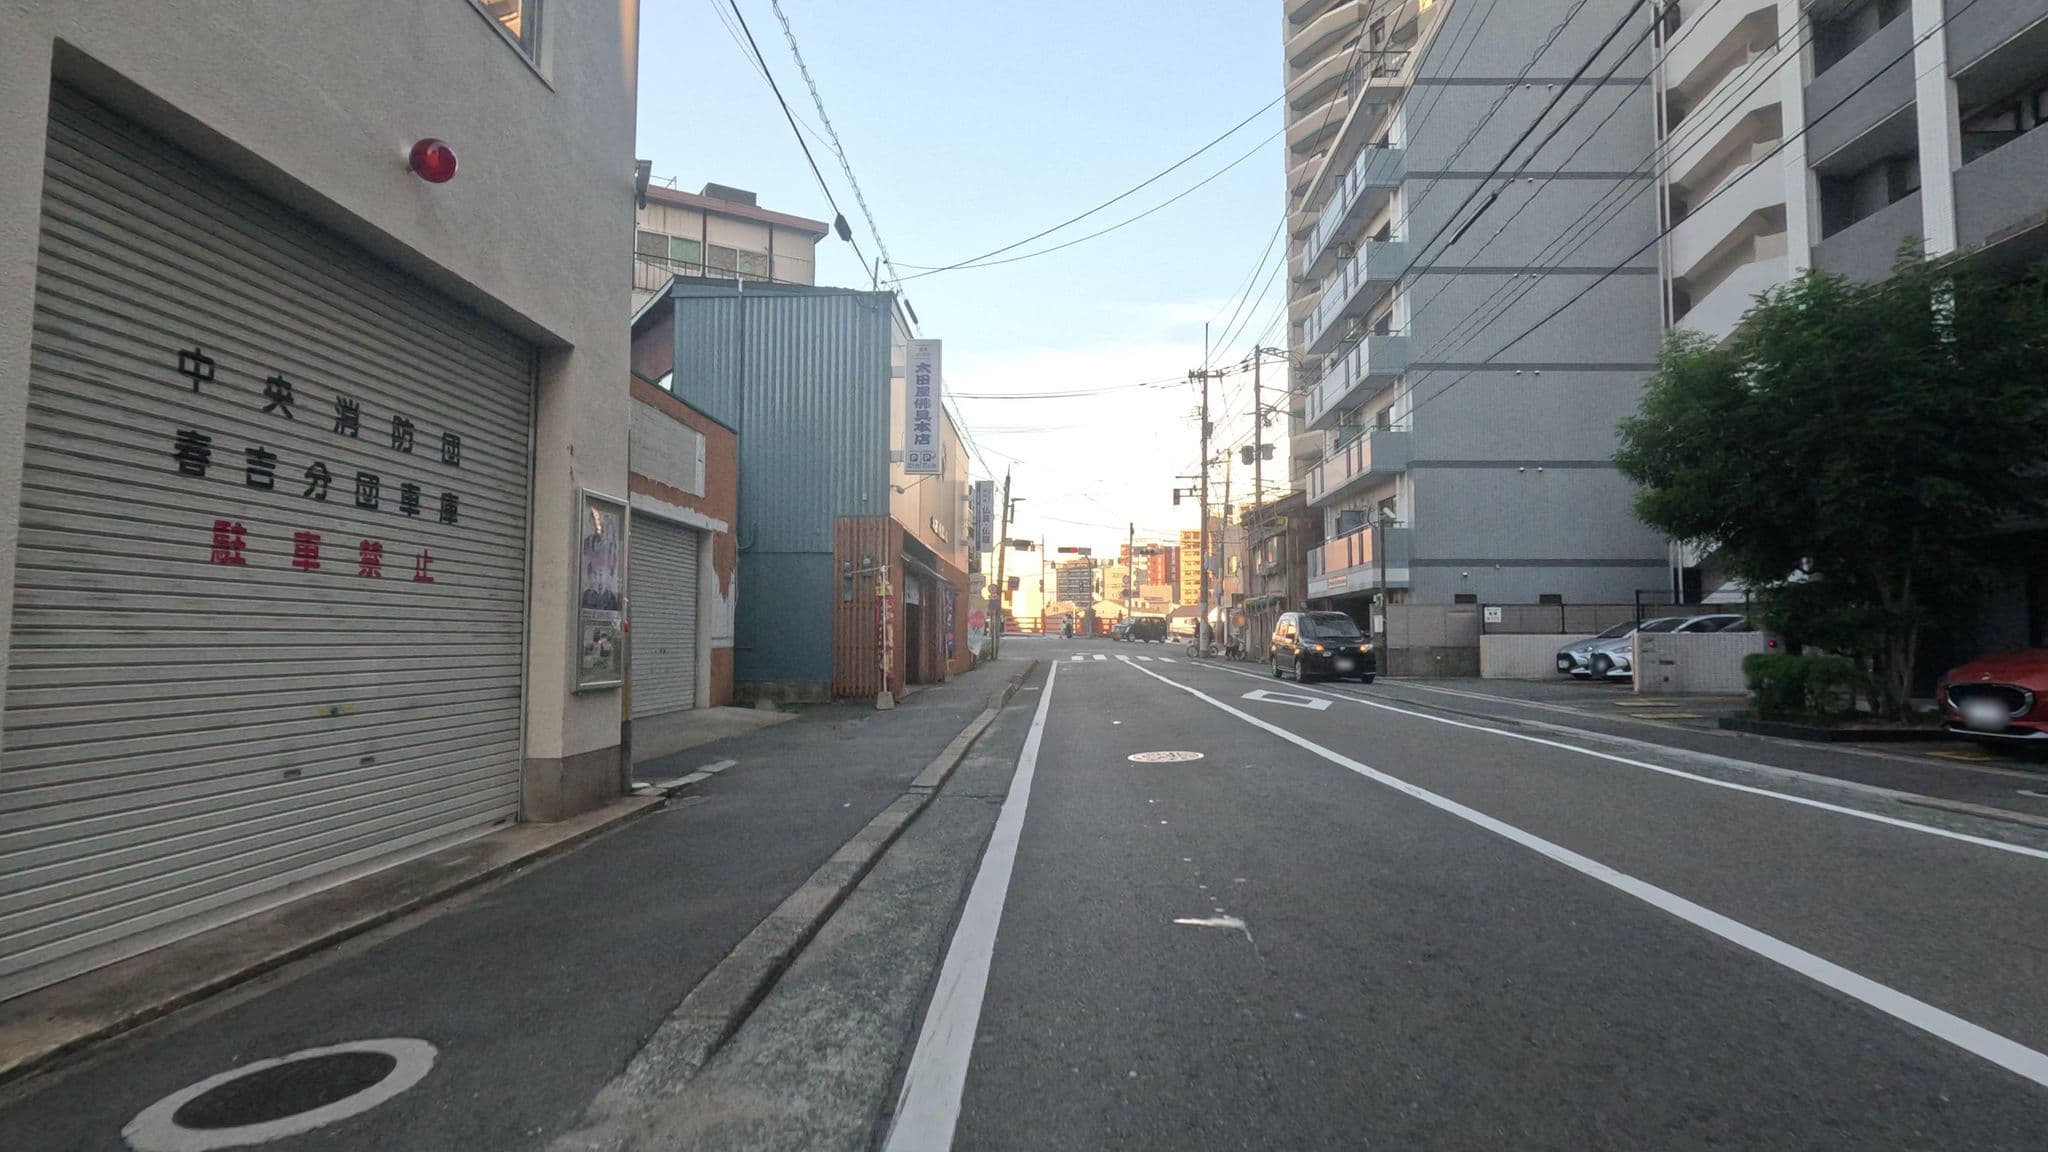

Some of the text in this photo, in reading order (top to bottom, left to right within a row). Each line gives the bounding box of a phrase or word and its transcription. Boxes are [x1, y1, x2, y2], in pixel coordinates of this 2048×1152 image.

[178, 347, 461, 468] 中央消防団
[174, 428, 460, 526] 春吉分団車庫
[210, 519, 435, 584] 駐車禁止
